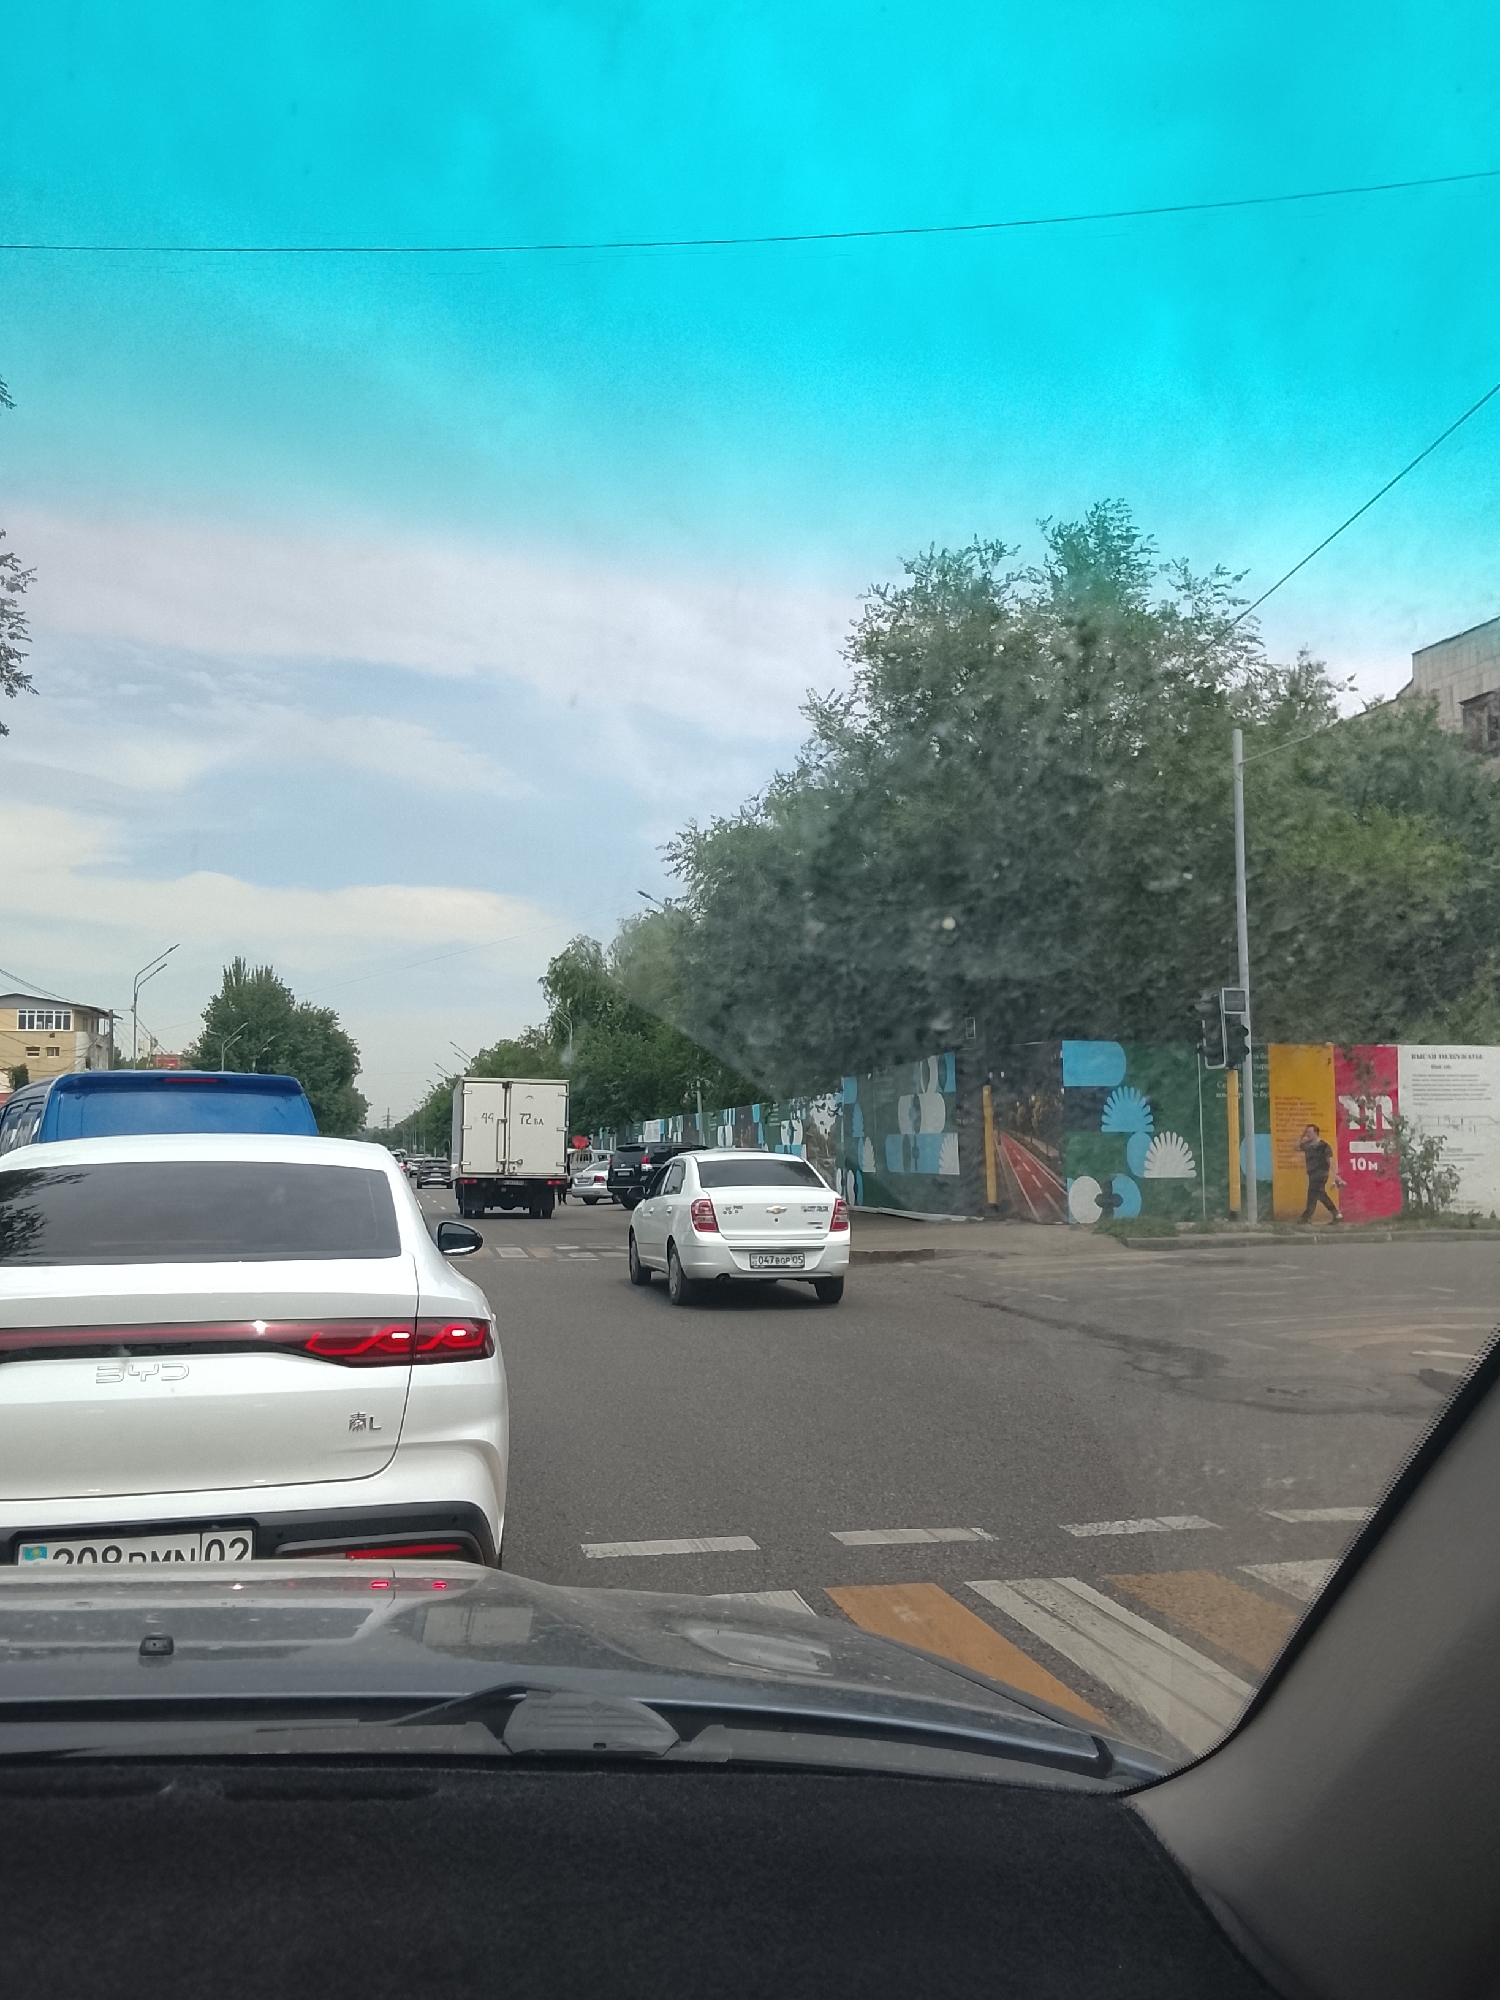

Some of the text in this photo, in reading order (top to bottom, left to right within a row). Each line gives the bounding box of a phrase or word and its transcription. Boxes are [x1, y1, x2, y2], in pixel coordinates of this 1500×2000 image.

[519, 1113, 532, 1125] 72
[1350, 1157, 1367, 1171] 10
[758, 1255, 775, 1265] 047
[792, 1255, 804, 1264] 05
[96, 1363, 190, 1384] BYD
